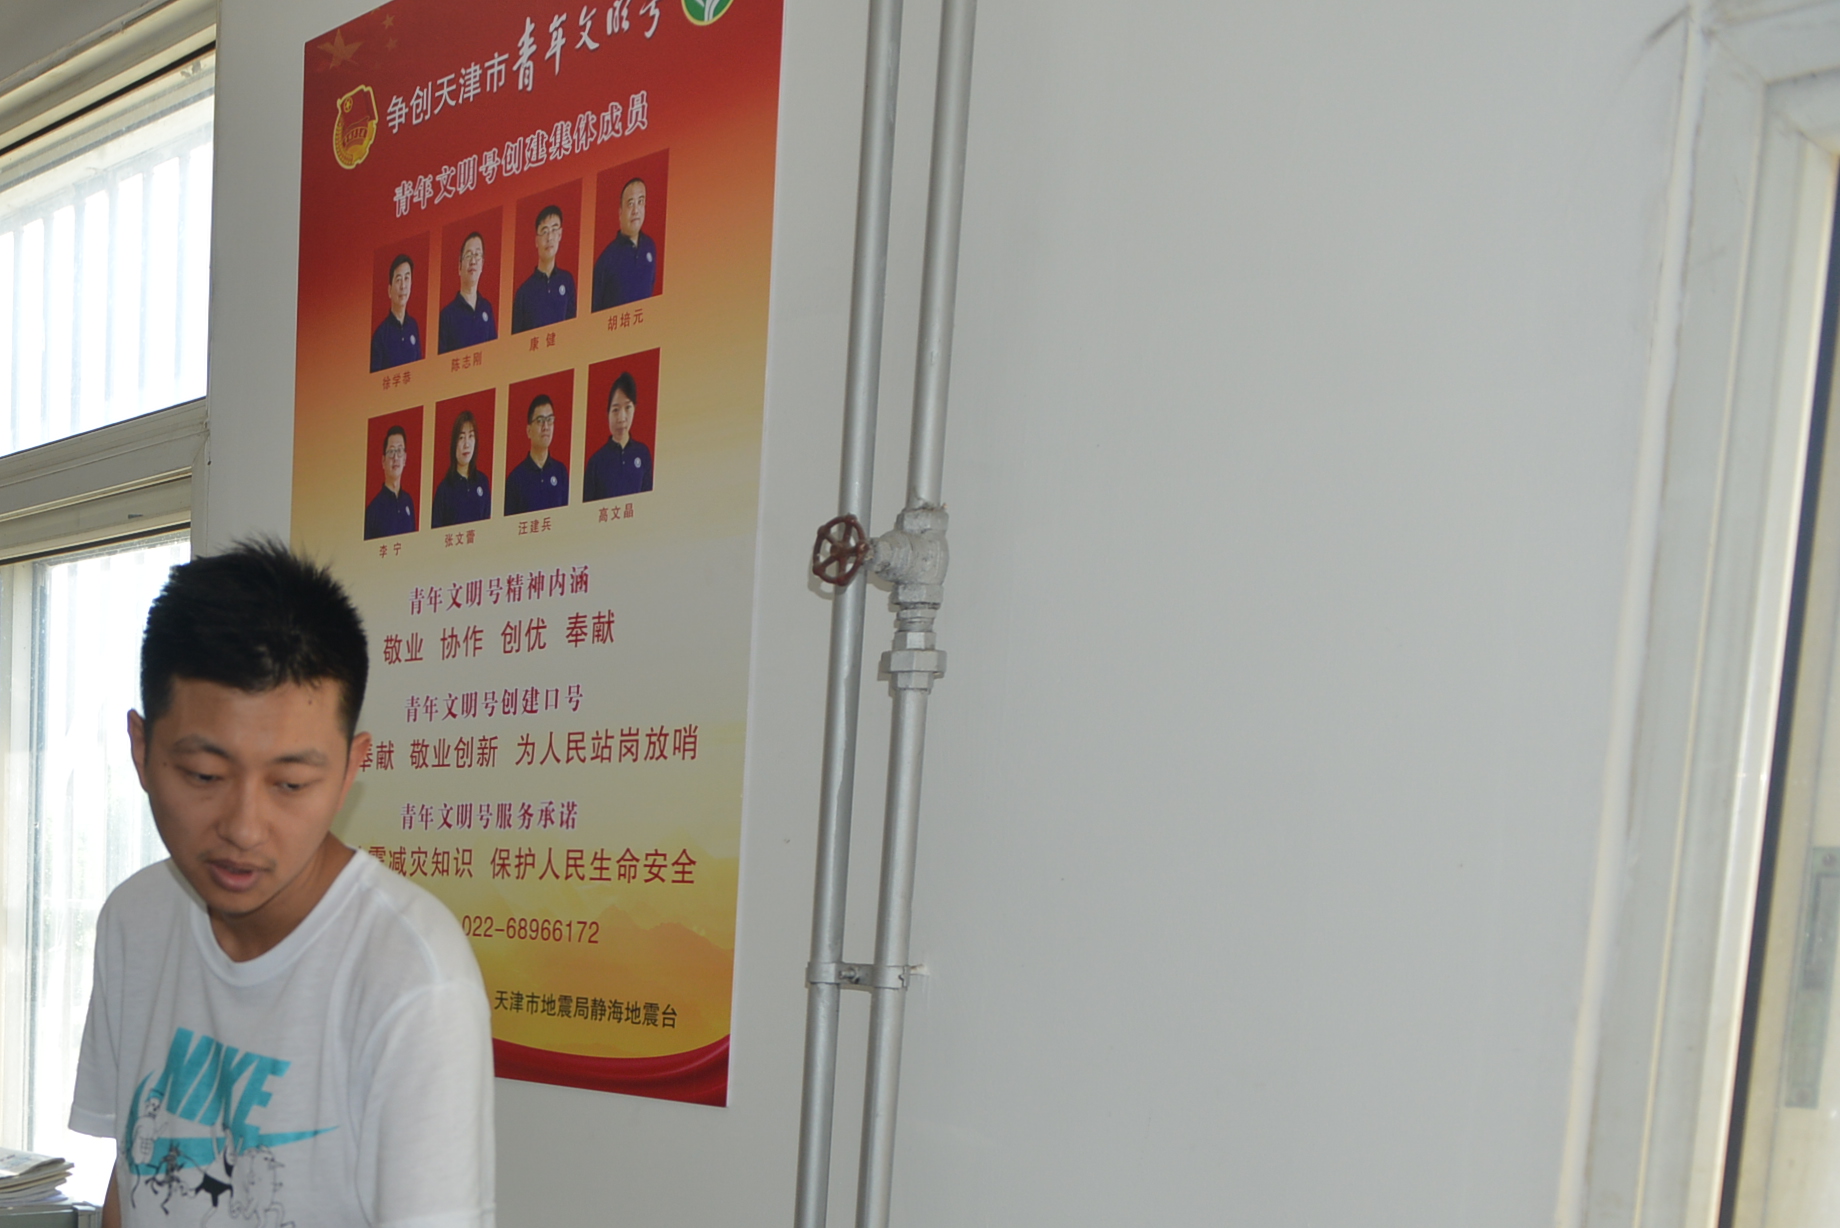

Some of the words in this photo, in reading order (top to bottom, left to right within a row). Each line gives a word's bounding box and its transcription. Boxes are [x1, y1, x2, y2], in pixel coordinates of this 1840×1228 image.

[393, 90, 649, 218] 青年文明号创建集体成员
[607, 308, 644, 332] 胡培元
[450, 351, 483, 372] 陈志刚
[518, 516, 552, 536] 汪建兵
[598, 503, 634, 523] 高文晶
[410, 564, 589, 615] 青年文明号精神内涵
[383, 632, 424, 665] 敬业
[440, 624, 484, 660] 协作
[501, 616, 547, 655] 创优
[565, 609, 615, 648] 奉献
[404, 683, 584, 723] 青年文明号创建口号
[409, 735, 499, 771] 敬业创新
[515, 723, 699, 766] 为人民站岗放哨
[400, 801, 578, 831] 青年文明号服务承诺
[490, 846, 698, 885] 保护人民生命安全
[462, 915, 600, 944] 022-68966172
[494, 990, 678, 1029] 天津市地震局静海地震台
[148, 1026, 292, 1156] NIKE
